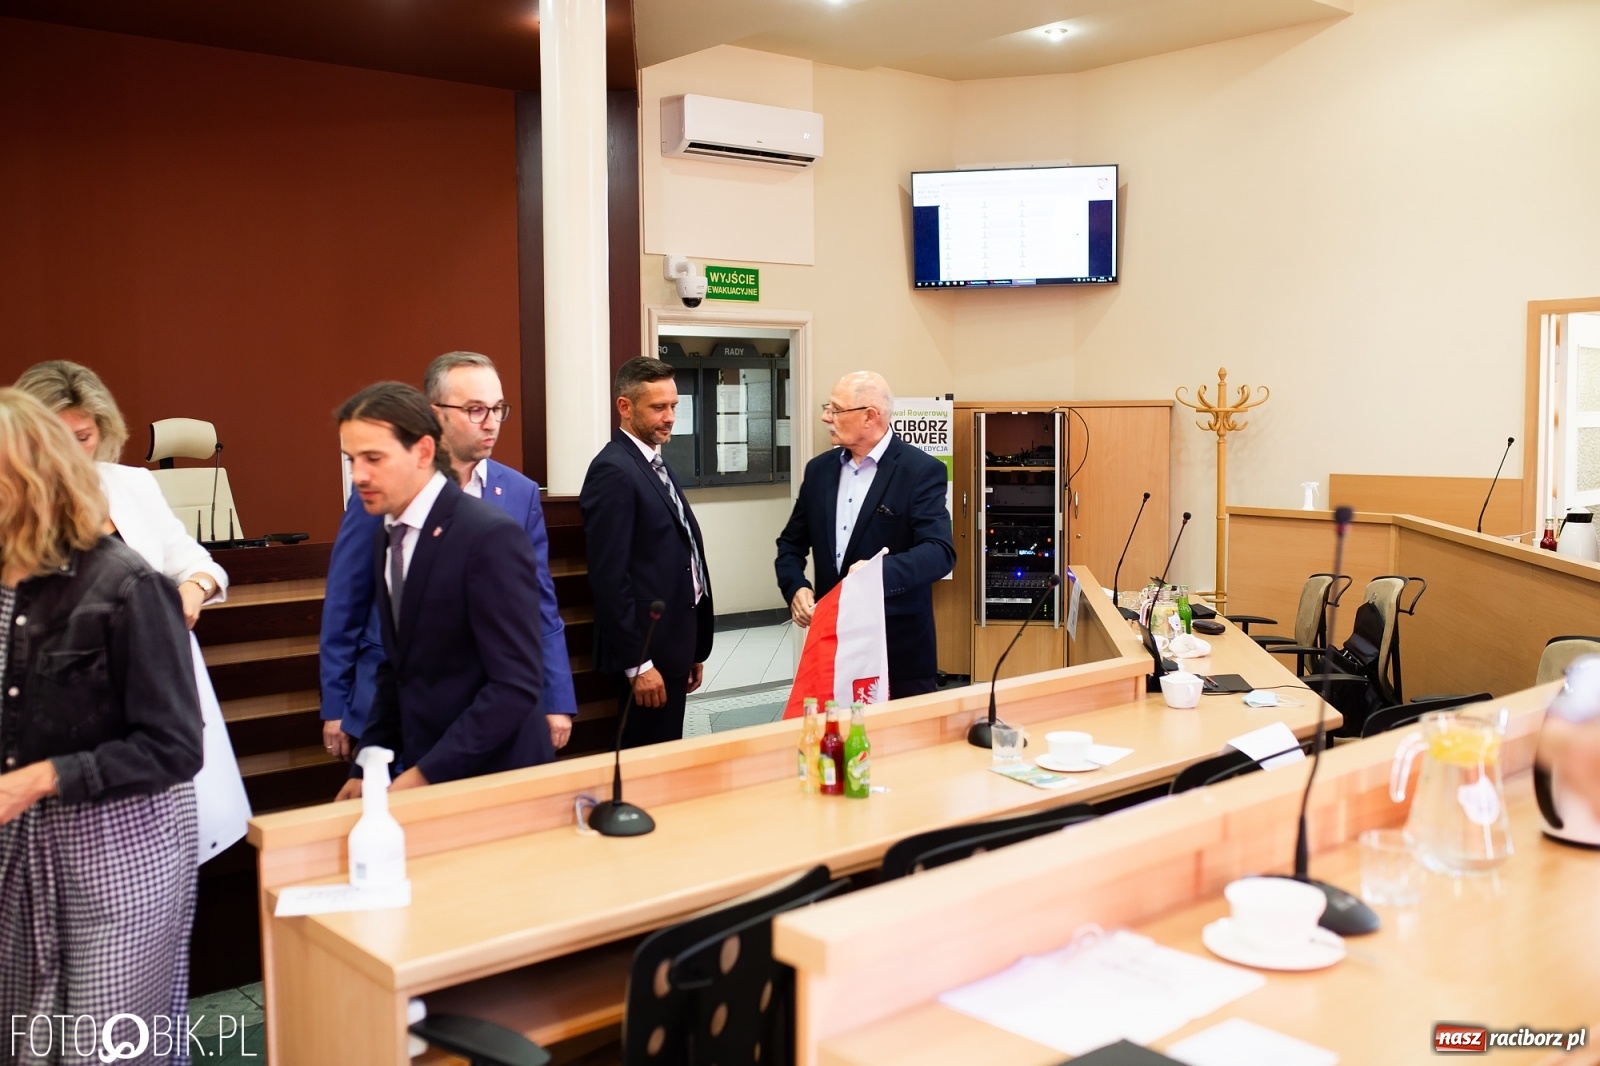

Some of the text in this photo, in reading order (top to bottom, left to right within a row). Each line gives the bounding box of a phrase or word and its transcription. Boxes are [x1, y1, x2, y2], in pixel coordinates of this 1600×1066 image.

[709, 271, 755, 285] WYJŚCIE
[707, 285, 758, 296] EWAKUACYJNE
[724, 347, 745, 356] RADY
[907, 409, 948, 418] Rowerowy
